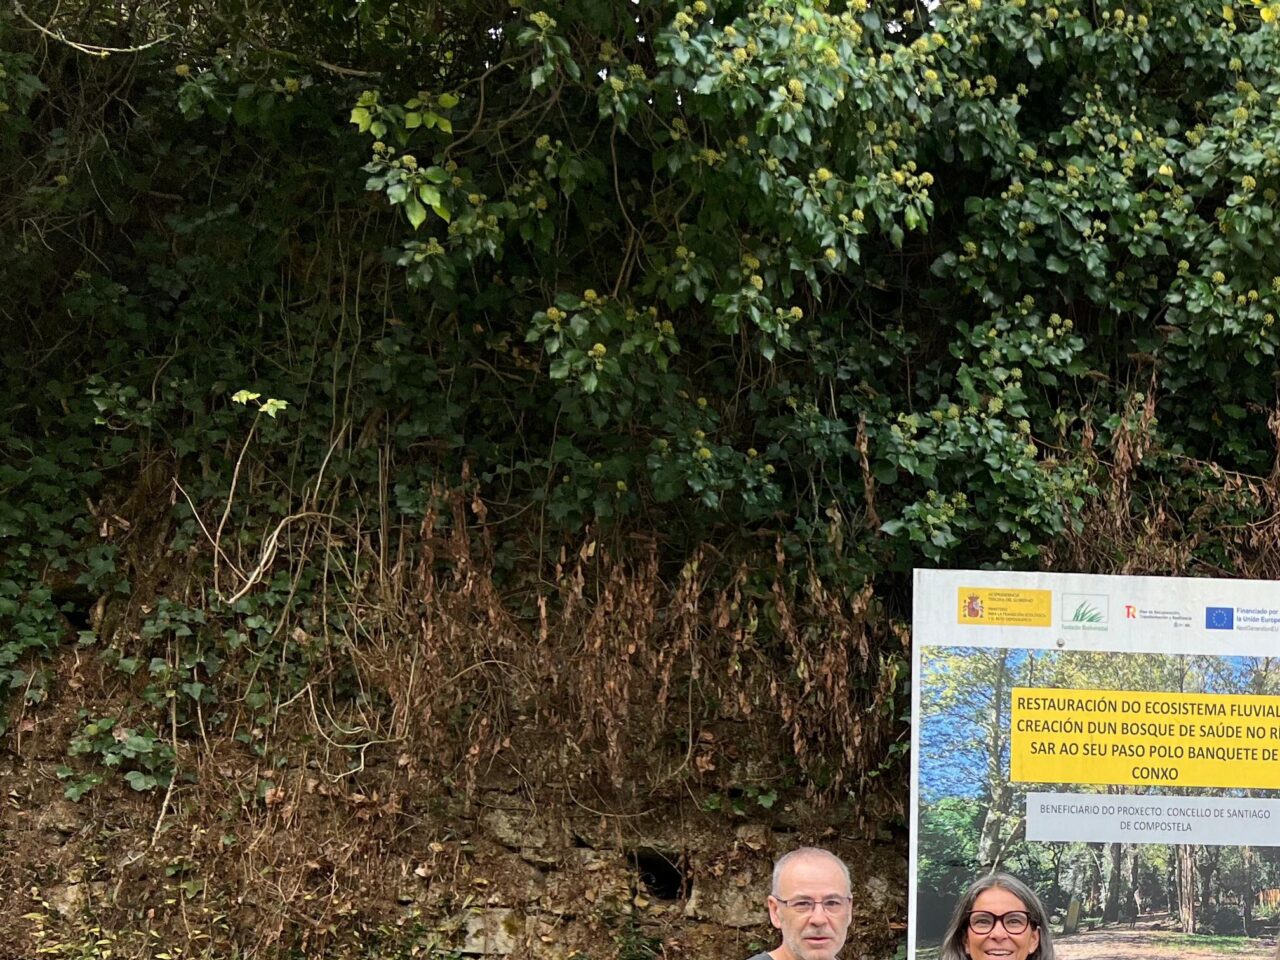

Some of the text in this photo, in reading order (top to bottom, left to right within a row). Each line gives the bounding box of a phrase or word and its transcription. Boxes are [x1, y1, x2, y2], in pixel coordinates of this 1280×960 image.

[1018, 697, 1116, 712] RESTAURACIÓN
[1122, 701, 1141, 713] DO
[1146, 702, 1226, 716] ECOSISTEMA
[1231, 704, 1280, 717] FLUVIAL
[1017, 718, 1083, 733] CREACIÓN
[1088, 722, 1116, 734] DUN
[1122, 723, 1175, 737] BOSQUE
[1180, 725, 1195, 737] DE
[1200, 722, 1242, 738] SAÚDE
[1247, 727, 1265, 739] NO
[1031, 742, 1278, 761] SAR AO SEU PASO POLO BANQUETE DE
[1132, 767, 1178, 780] CONXO
[1040, 804, 1270, 819] BENEFICIARIO DO PROXECTO: CONCELLO DE SANTIAGO
[1120, 821, 1192, 831] DE COMPOSTELA
